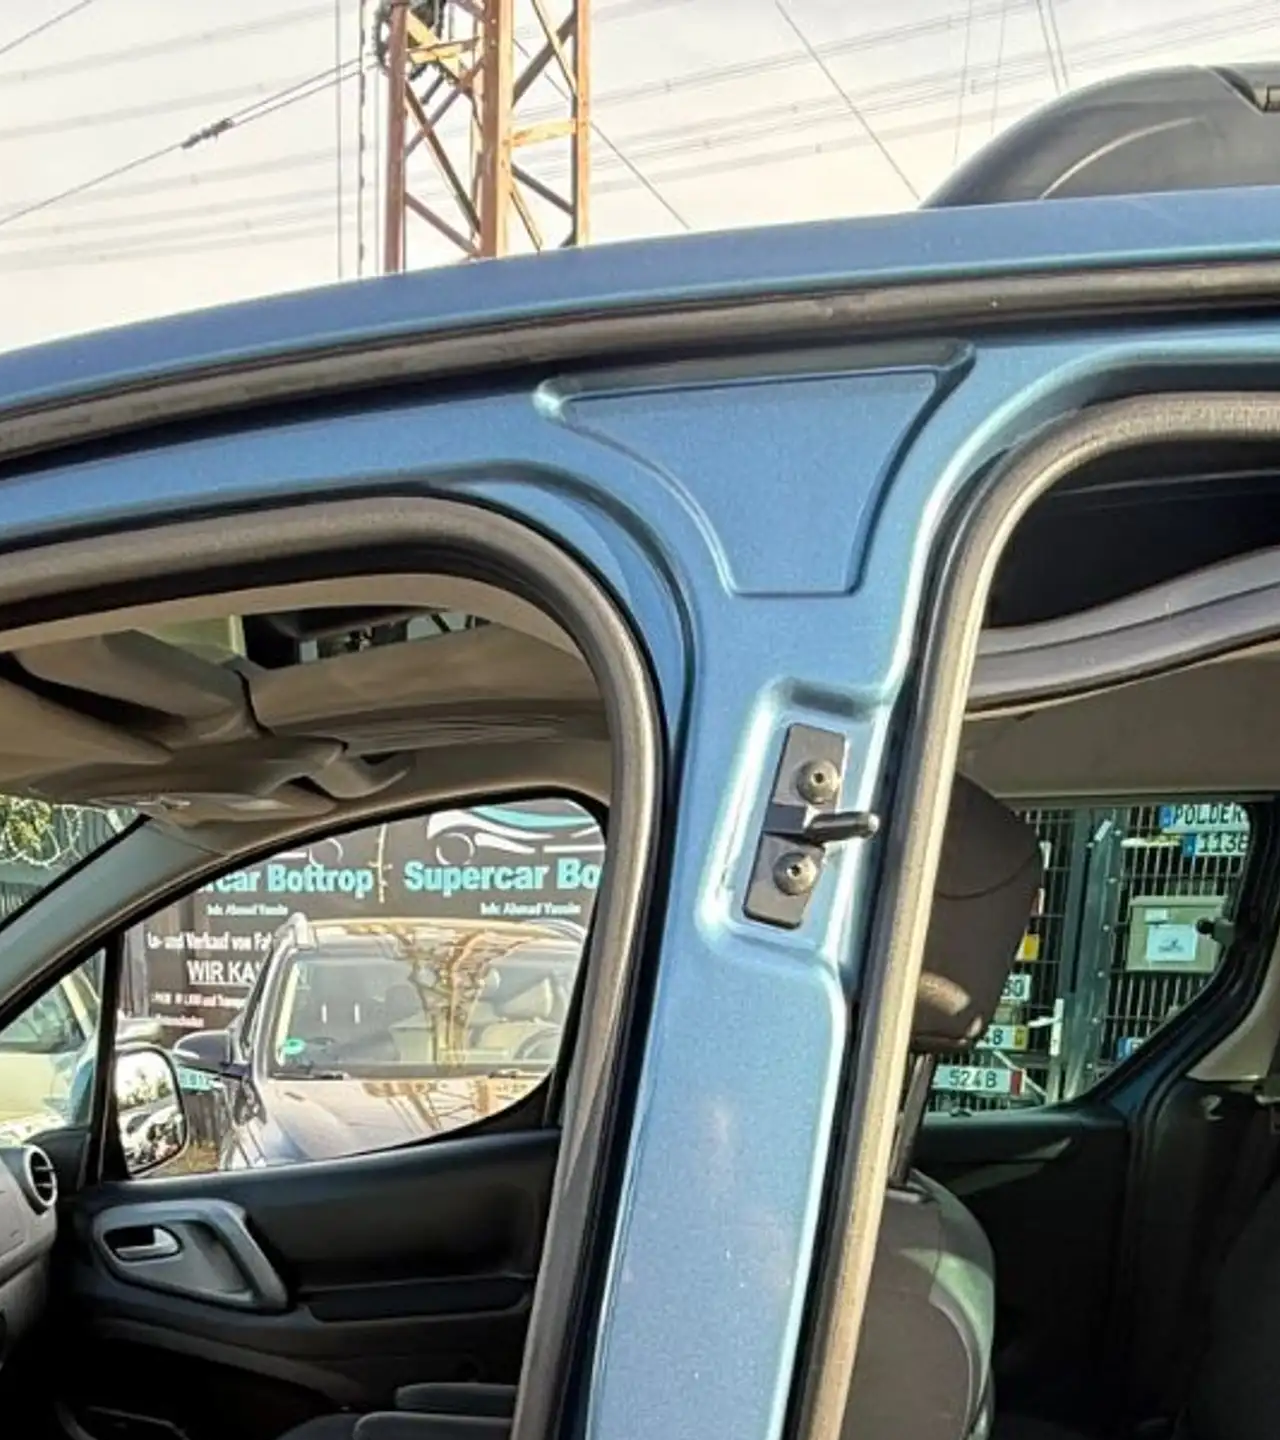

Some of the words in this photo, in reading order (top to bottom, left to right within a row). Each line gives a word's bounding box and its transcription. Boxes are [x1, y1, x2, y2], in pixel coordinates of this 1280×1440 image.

[268, 864, 374, 898] Bottrop
[404, 861, 550, 898] Supercar
[186, 959, 223, 983] WIR
